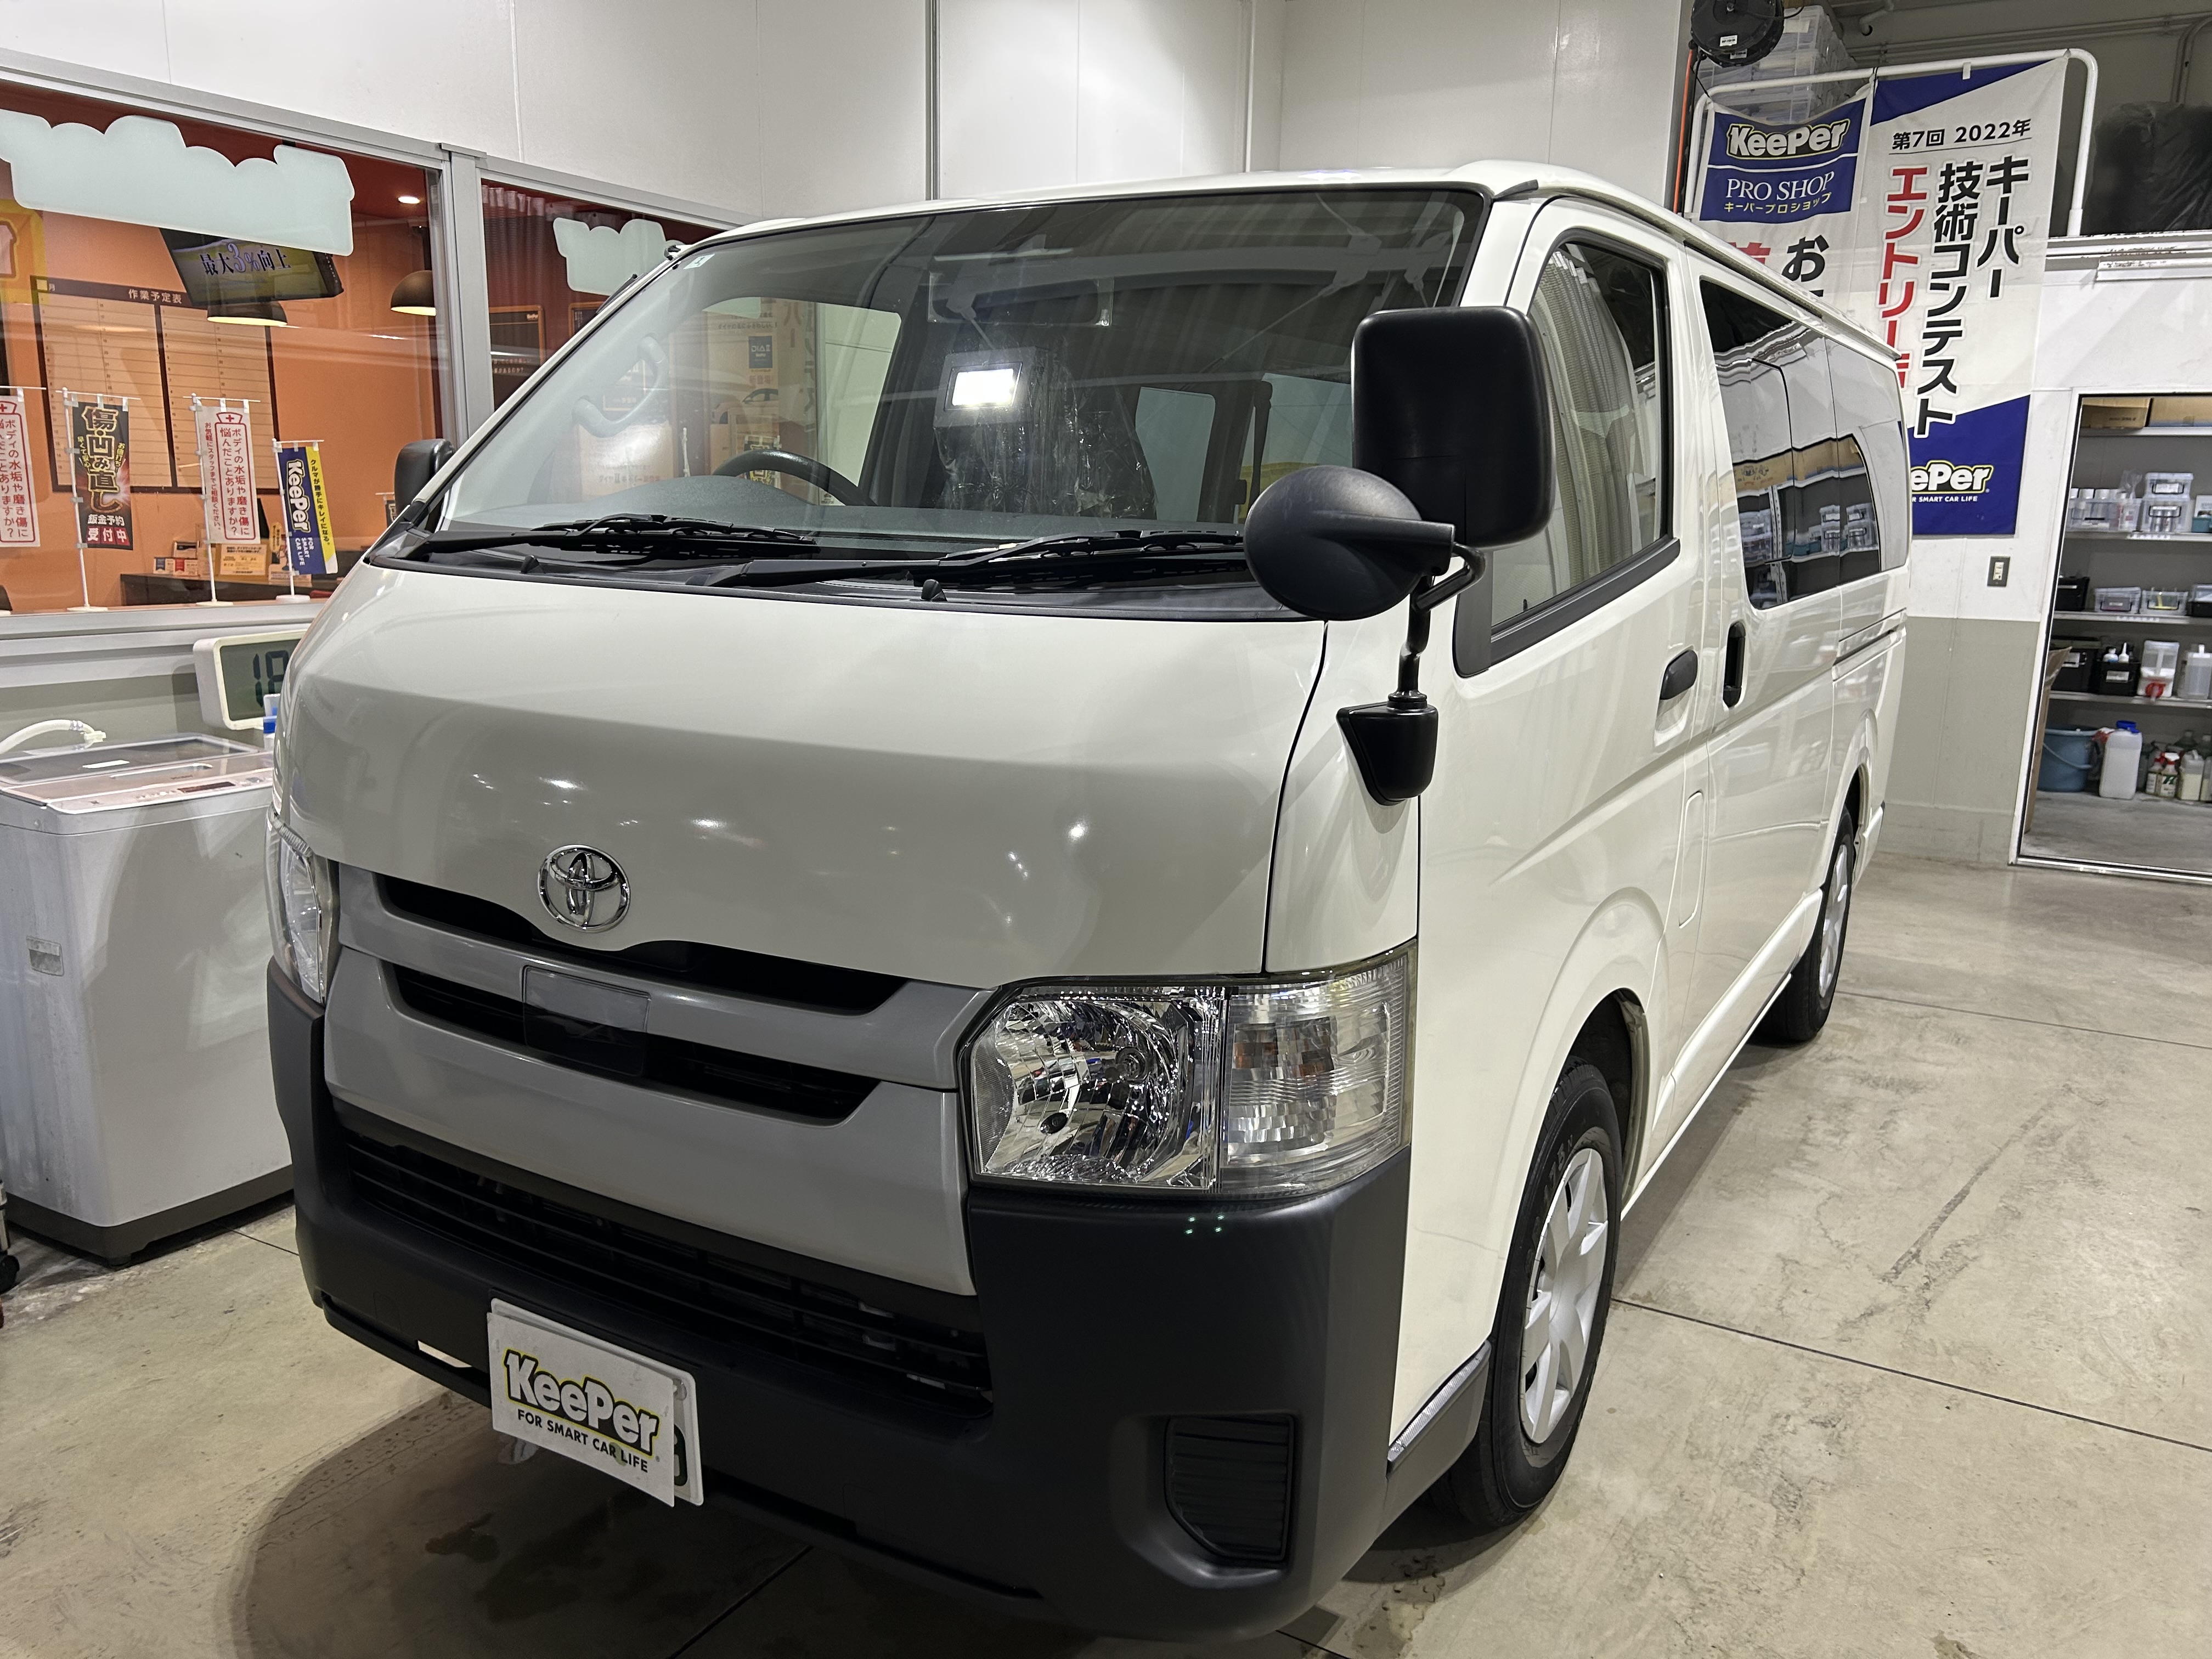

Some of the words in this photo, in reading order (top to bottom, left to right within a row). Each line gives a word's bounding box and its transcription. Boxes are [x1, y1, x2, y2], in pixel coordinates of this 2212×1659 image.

[1727, 119, 1850, 159] KeePer
[1892, 129, 1945, 150] 第7回
[1954, 119, 2032, 144] 2022年
[1724, 192, 1832, 214] キーパープロショップ
[1726, 178, 1771, 201] PRO
[1776, 171, 1835, 201] SHOP
[1977, 155, 2029, 298] キーパー
[200, 243, 291, 275] 最大3%向上
[128, 289, 182, 304] 作業予定表
[1917, 160, 1983, 436] 技術コンテスト
[5, 420, 29, 538] ボディの水垢や磨き傷に
[232, 428, 250, 535] ボディの水垢や磨き傷に
[287, 459, 311, 533] KeePer
[87, 514, 125, 527] 鈑金予約
[87, 527, 127, 543] 受付中
[301, 537, 310, 558] SMART
[503, 1348, 659, 1456] KeePer
[517, 1409, 542, 1429] FOR
[548, 1419, 588, 1445] SMART
[592, 1438, 617, 1458] CAR
[620, 1450, 648, 1473] LIFE
